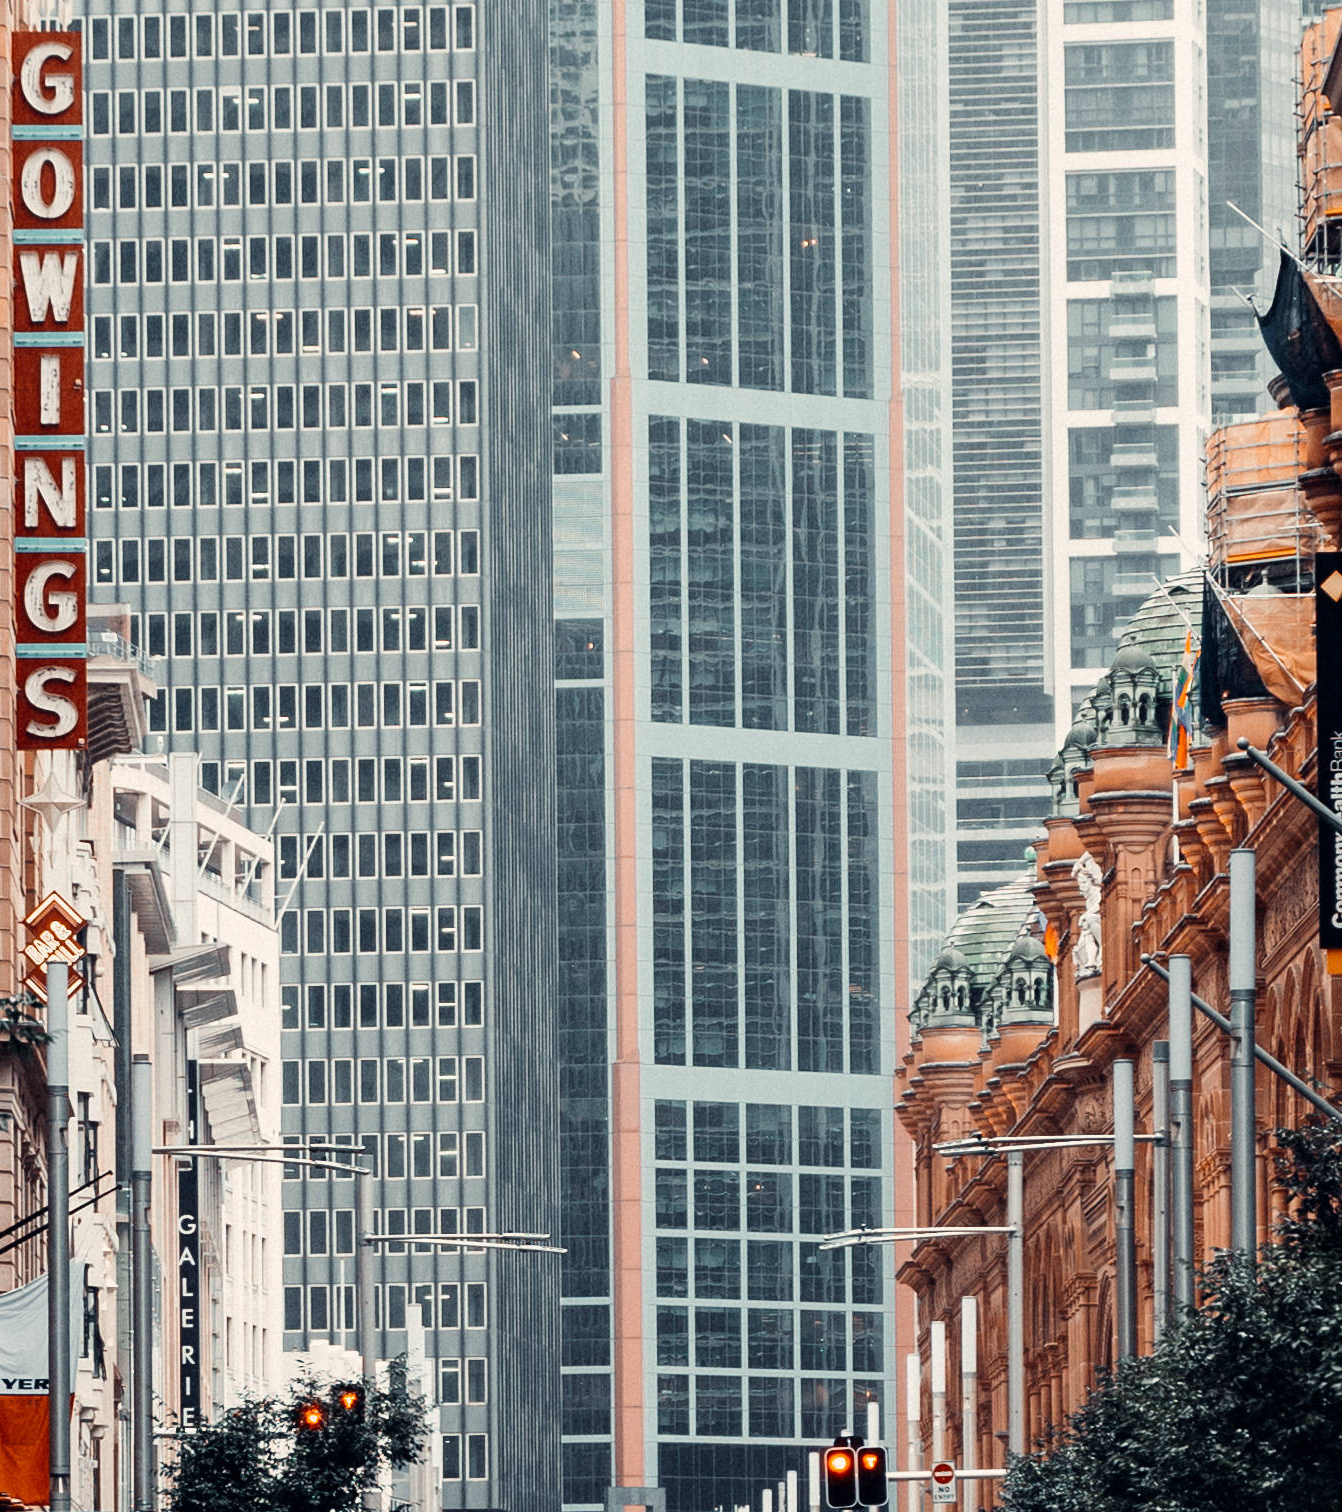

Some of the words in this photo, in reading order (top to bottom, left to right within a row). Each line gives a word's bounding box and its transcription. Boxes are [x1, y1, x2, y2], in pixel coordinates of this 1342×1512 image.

[20, 42, 79, 736] GOWINGS
[25, 930, 60, 965] BAR
[50, 920, 72, 940] &
